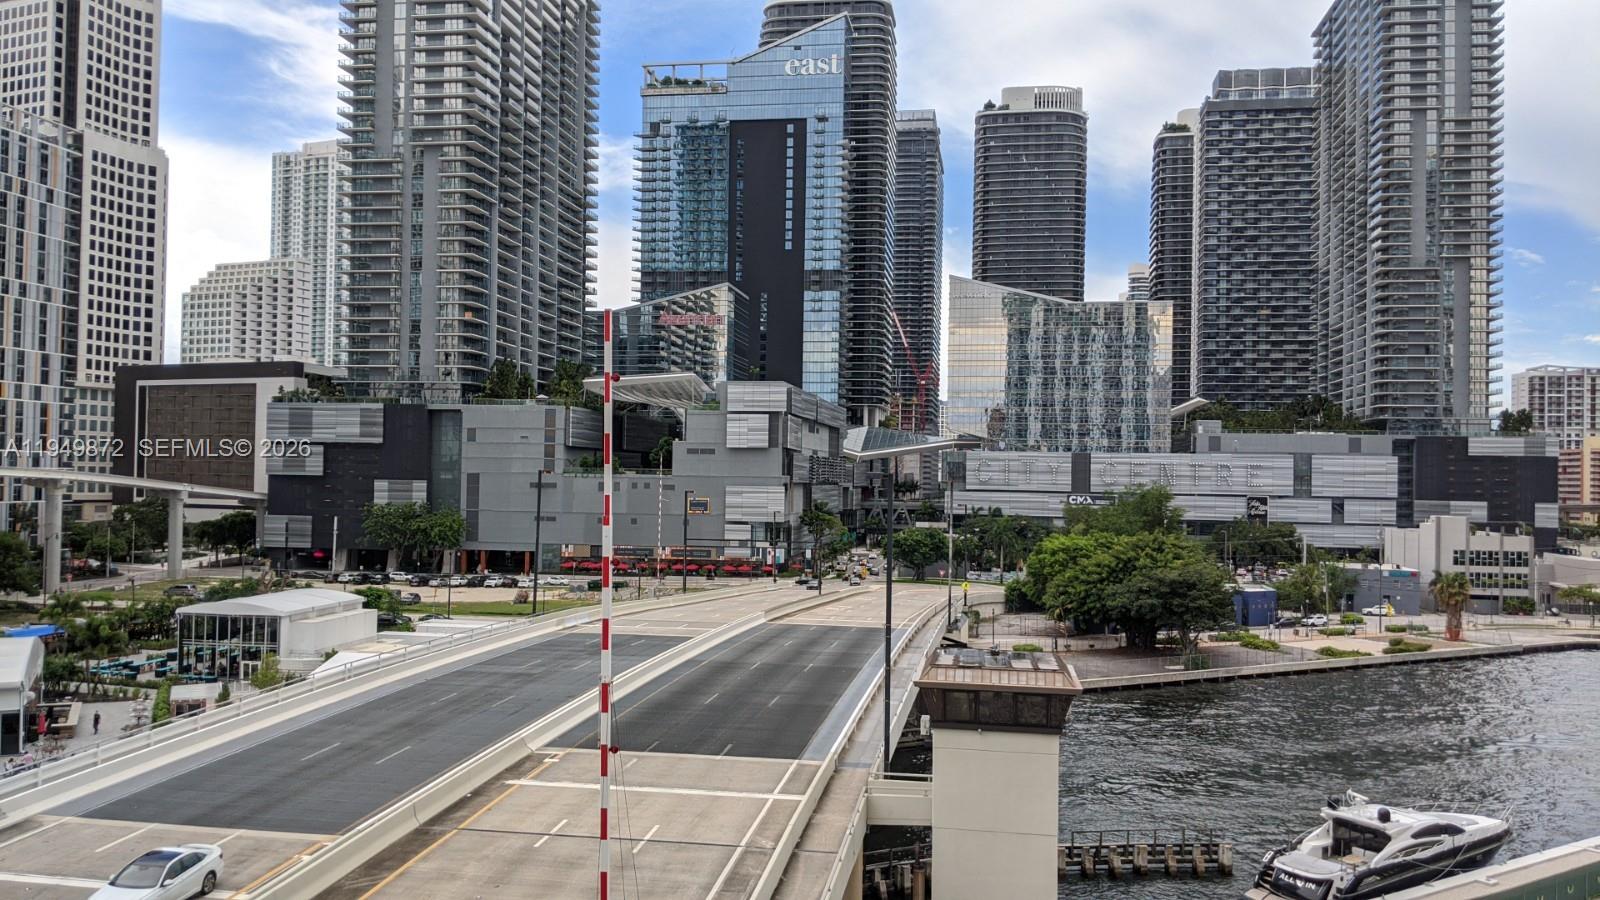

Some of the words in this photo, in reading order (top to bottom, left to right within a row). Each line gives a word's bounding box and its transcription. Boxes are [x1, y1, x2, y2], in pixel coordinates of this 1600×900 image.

[784, 54, 842, 76] east
[974, 458, 1063, 484] CITY
[1101, 460, 1264, 487] CENTRE
[1279, 873, 1294, 884] ALL
